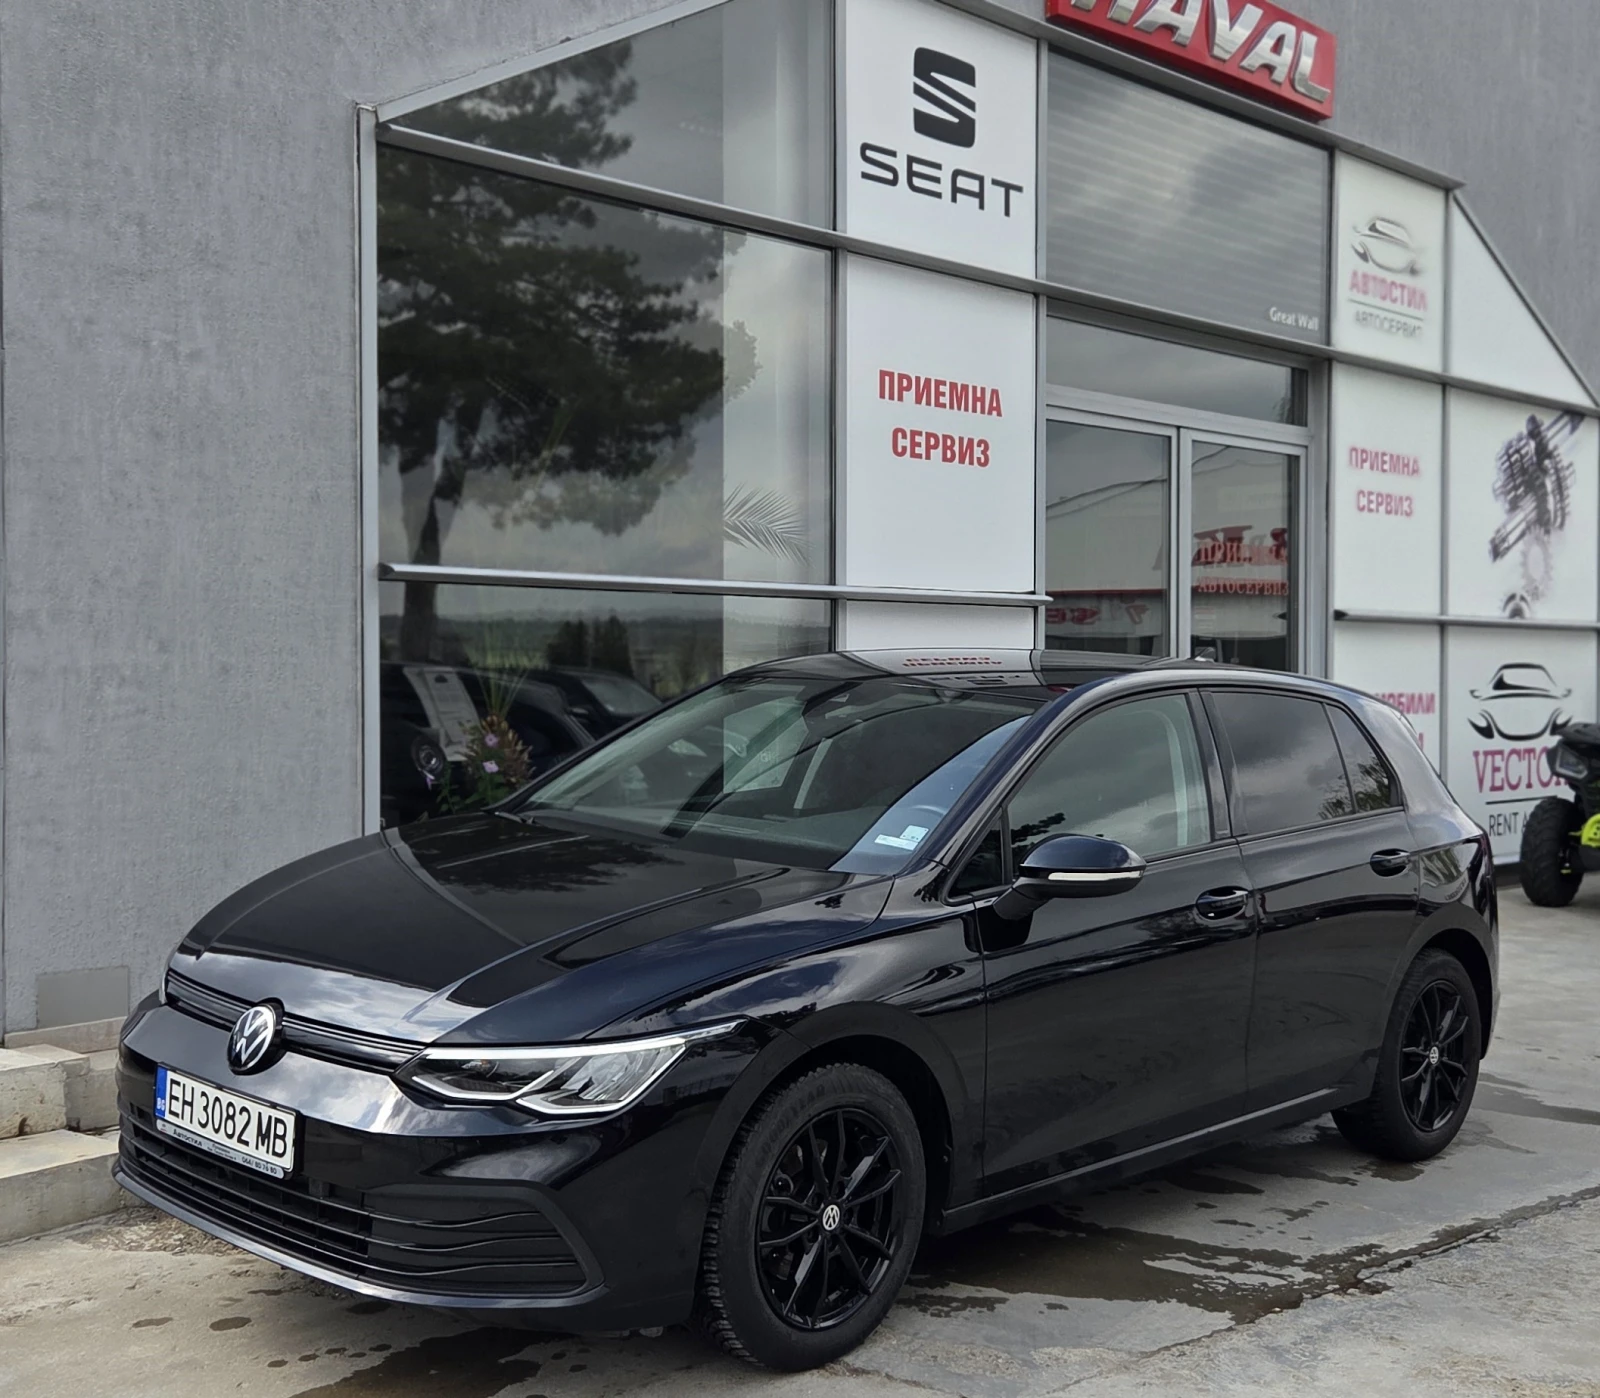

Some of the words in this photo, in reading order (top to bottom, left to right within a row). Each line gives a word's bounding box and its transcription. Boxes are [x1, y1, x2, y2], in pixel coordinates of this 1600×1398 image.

[1071, 0, 1331, 104] AVAL
[860, 142, 1023, 217] SEAT
[1269, 307, 1297, 327] Great
[1299, 310, 1320, 331] Wall
[878, 369, 1003, 417] ПРИЕМНА
[892, 427, 990, 468] СЕРВИЗ
[1349, 446, 1420, 476] ПРИЕМНА
[1357, 489, 1414, 518] СЕРВИЗ
[1197, 576, 1289, 596] АВТОСЕРВИЗ
[1472, 746, 1571, 794] VECTO
[1488, 811, 1519, 837] RENT
